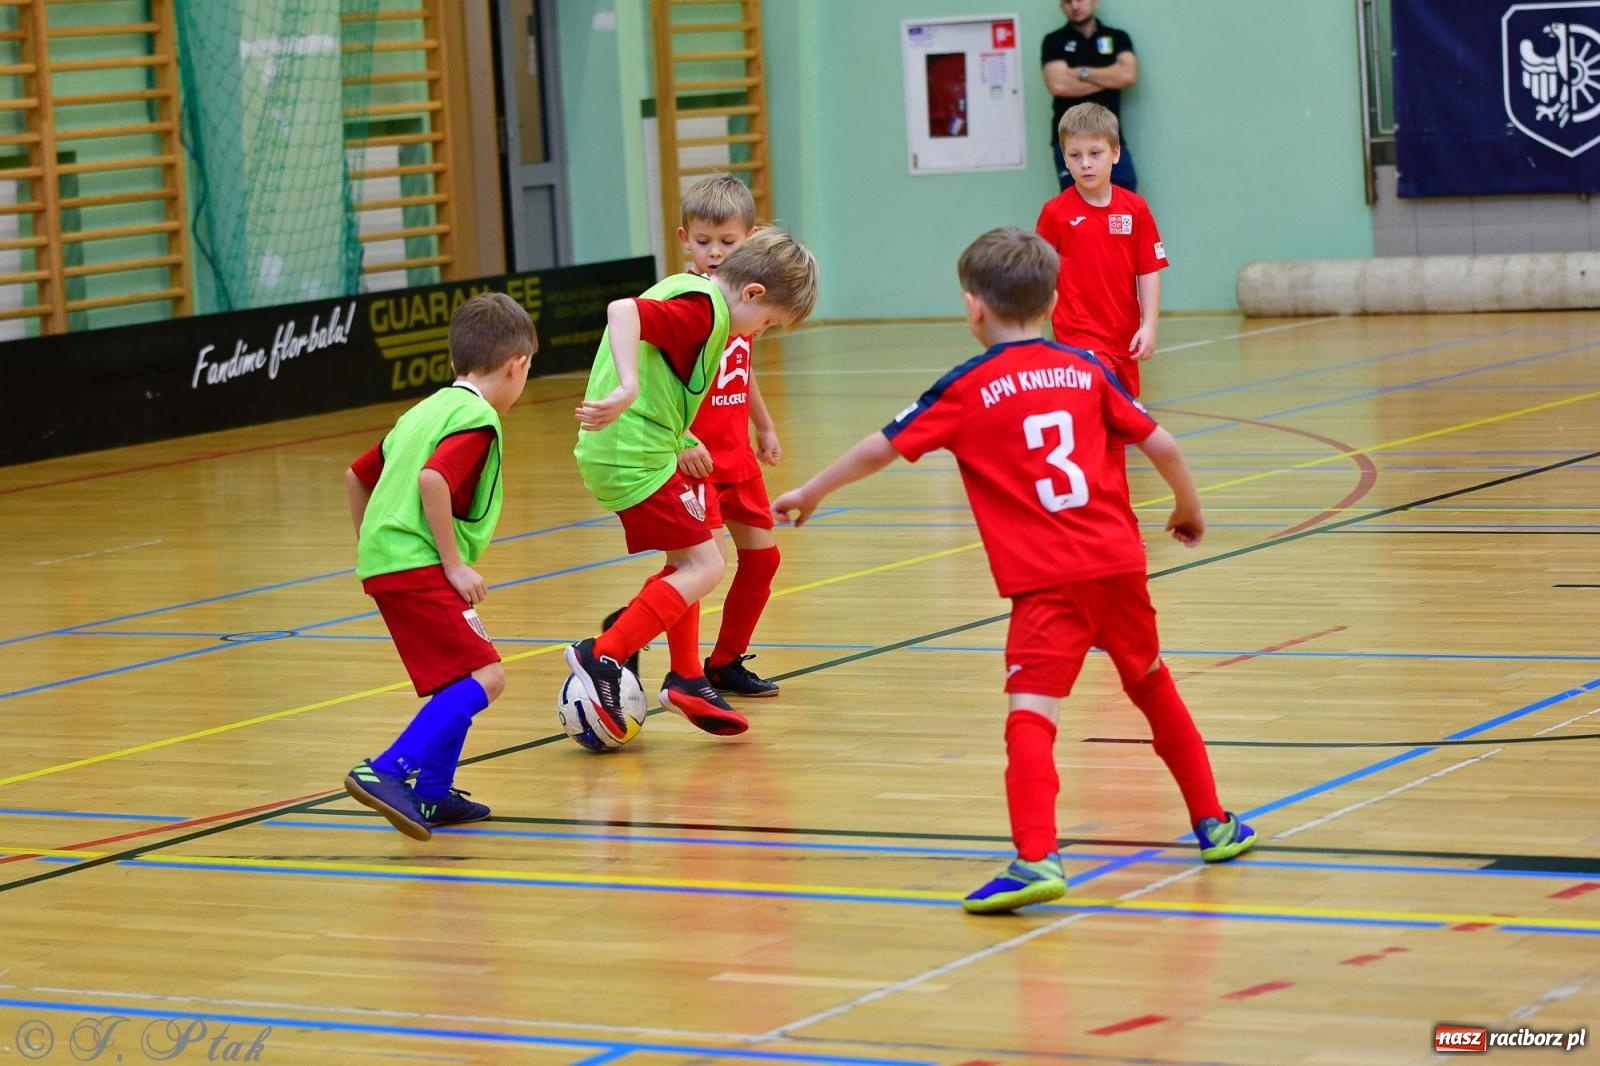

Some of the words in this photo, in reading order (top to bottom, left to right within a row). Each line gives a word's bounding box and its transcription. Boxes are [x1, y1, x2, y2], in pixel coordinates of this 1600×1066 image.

[980, 374, 1017, 409] APN
[1017, 364, 1092, 391] KNURÓW
[1022, 410, 1090, 513] 3
